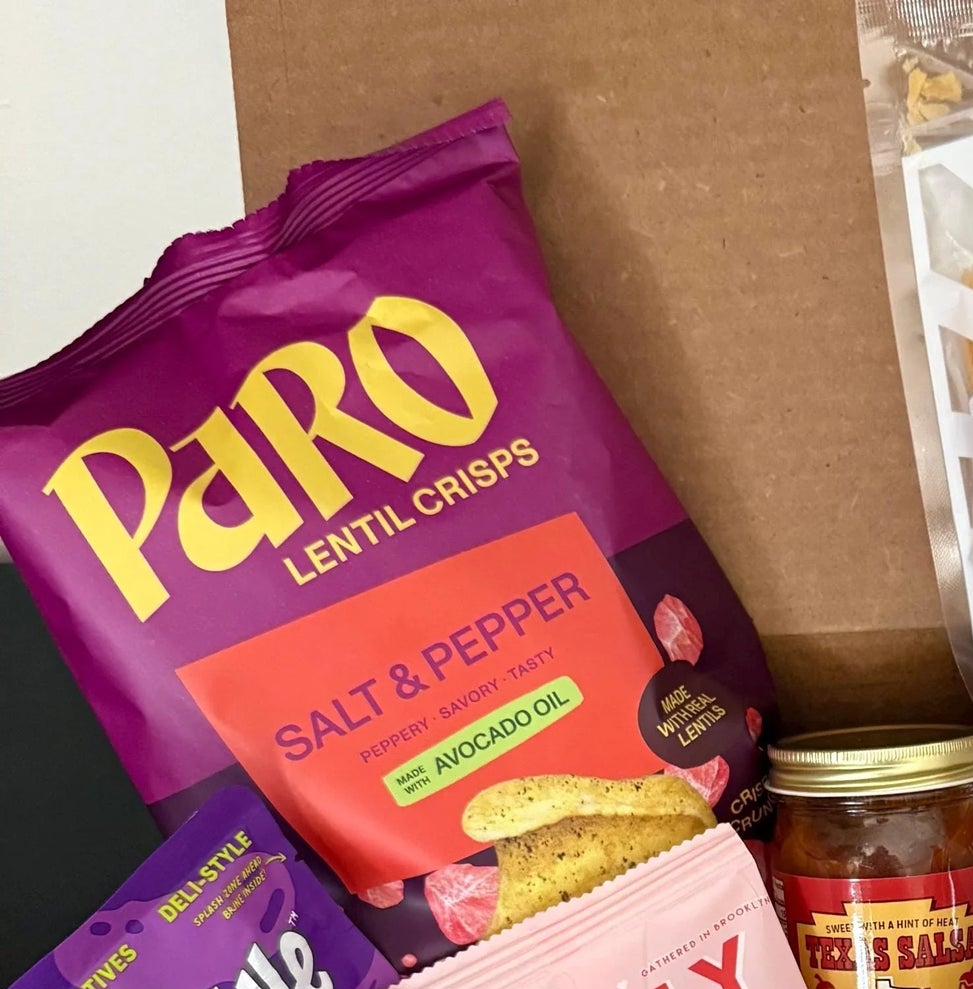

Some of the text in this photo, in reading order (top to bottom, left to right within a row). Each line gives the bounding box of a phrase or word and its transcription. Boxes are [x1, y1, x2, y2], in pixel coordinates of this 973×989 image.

[282, 437, 540, 586] LENTIL CRISPS
[274, 570, 592, 762] SALT & PEPPER
[359, 646, 557, 764] PEPPERY SAVORY TASTY
[656, 693, 717, 738] WITH REAL
[661, 685, 692, 714] MADE
[677, 705, 726, 747] LENTILS
[434, 689, 570, 776] AVOCADO OIL
[395, 765, 427, 788] MADE
[403, 774, 432, 797] WITH
[157, 830, 253, 924] DELI-STYLE
[193, 855, 263, 927] SPLASH ZONE AHEAD
[222, 894, 246, 920] BRINE
[888, 920, 894, 930] A
[896, 918, 919, 930] HINT
[922, 918, 934, 928] OF
[641, 940, 697, 978] GATHERED
[699, 930, 711, 943] IN
[713, 896, 770, 932] BROOKLYN
